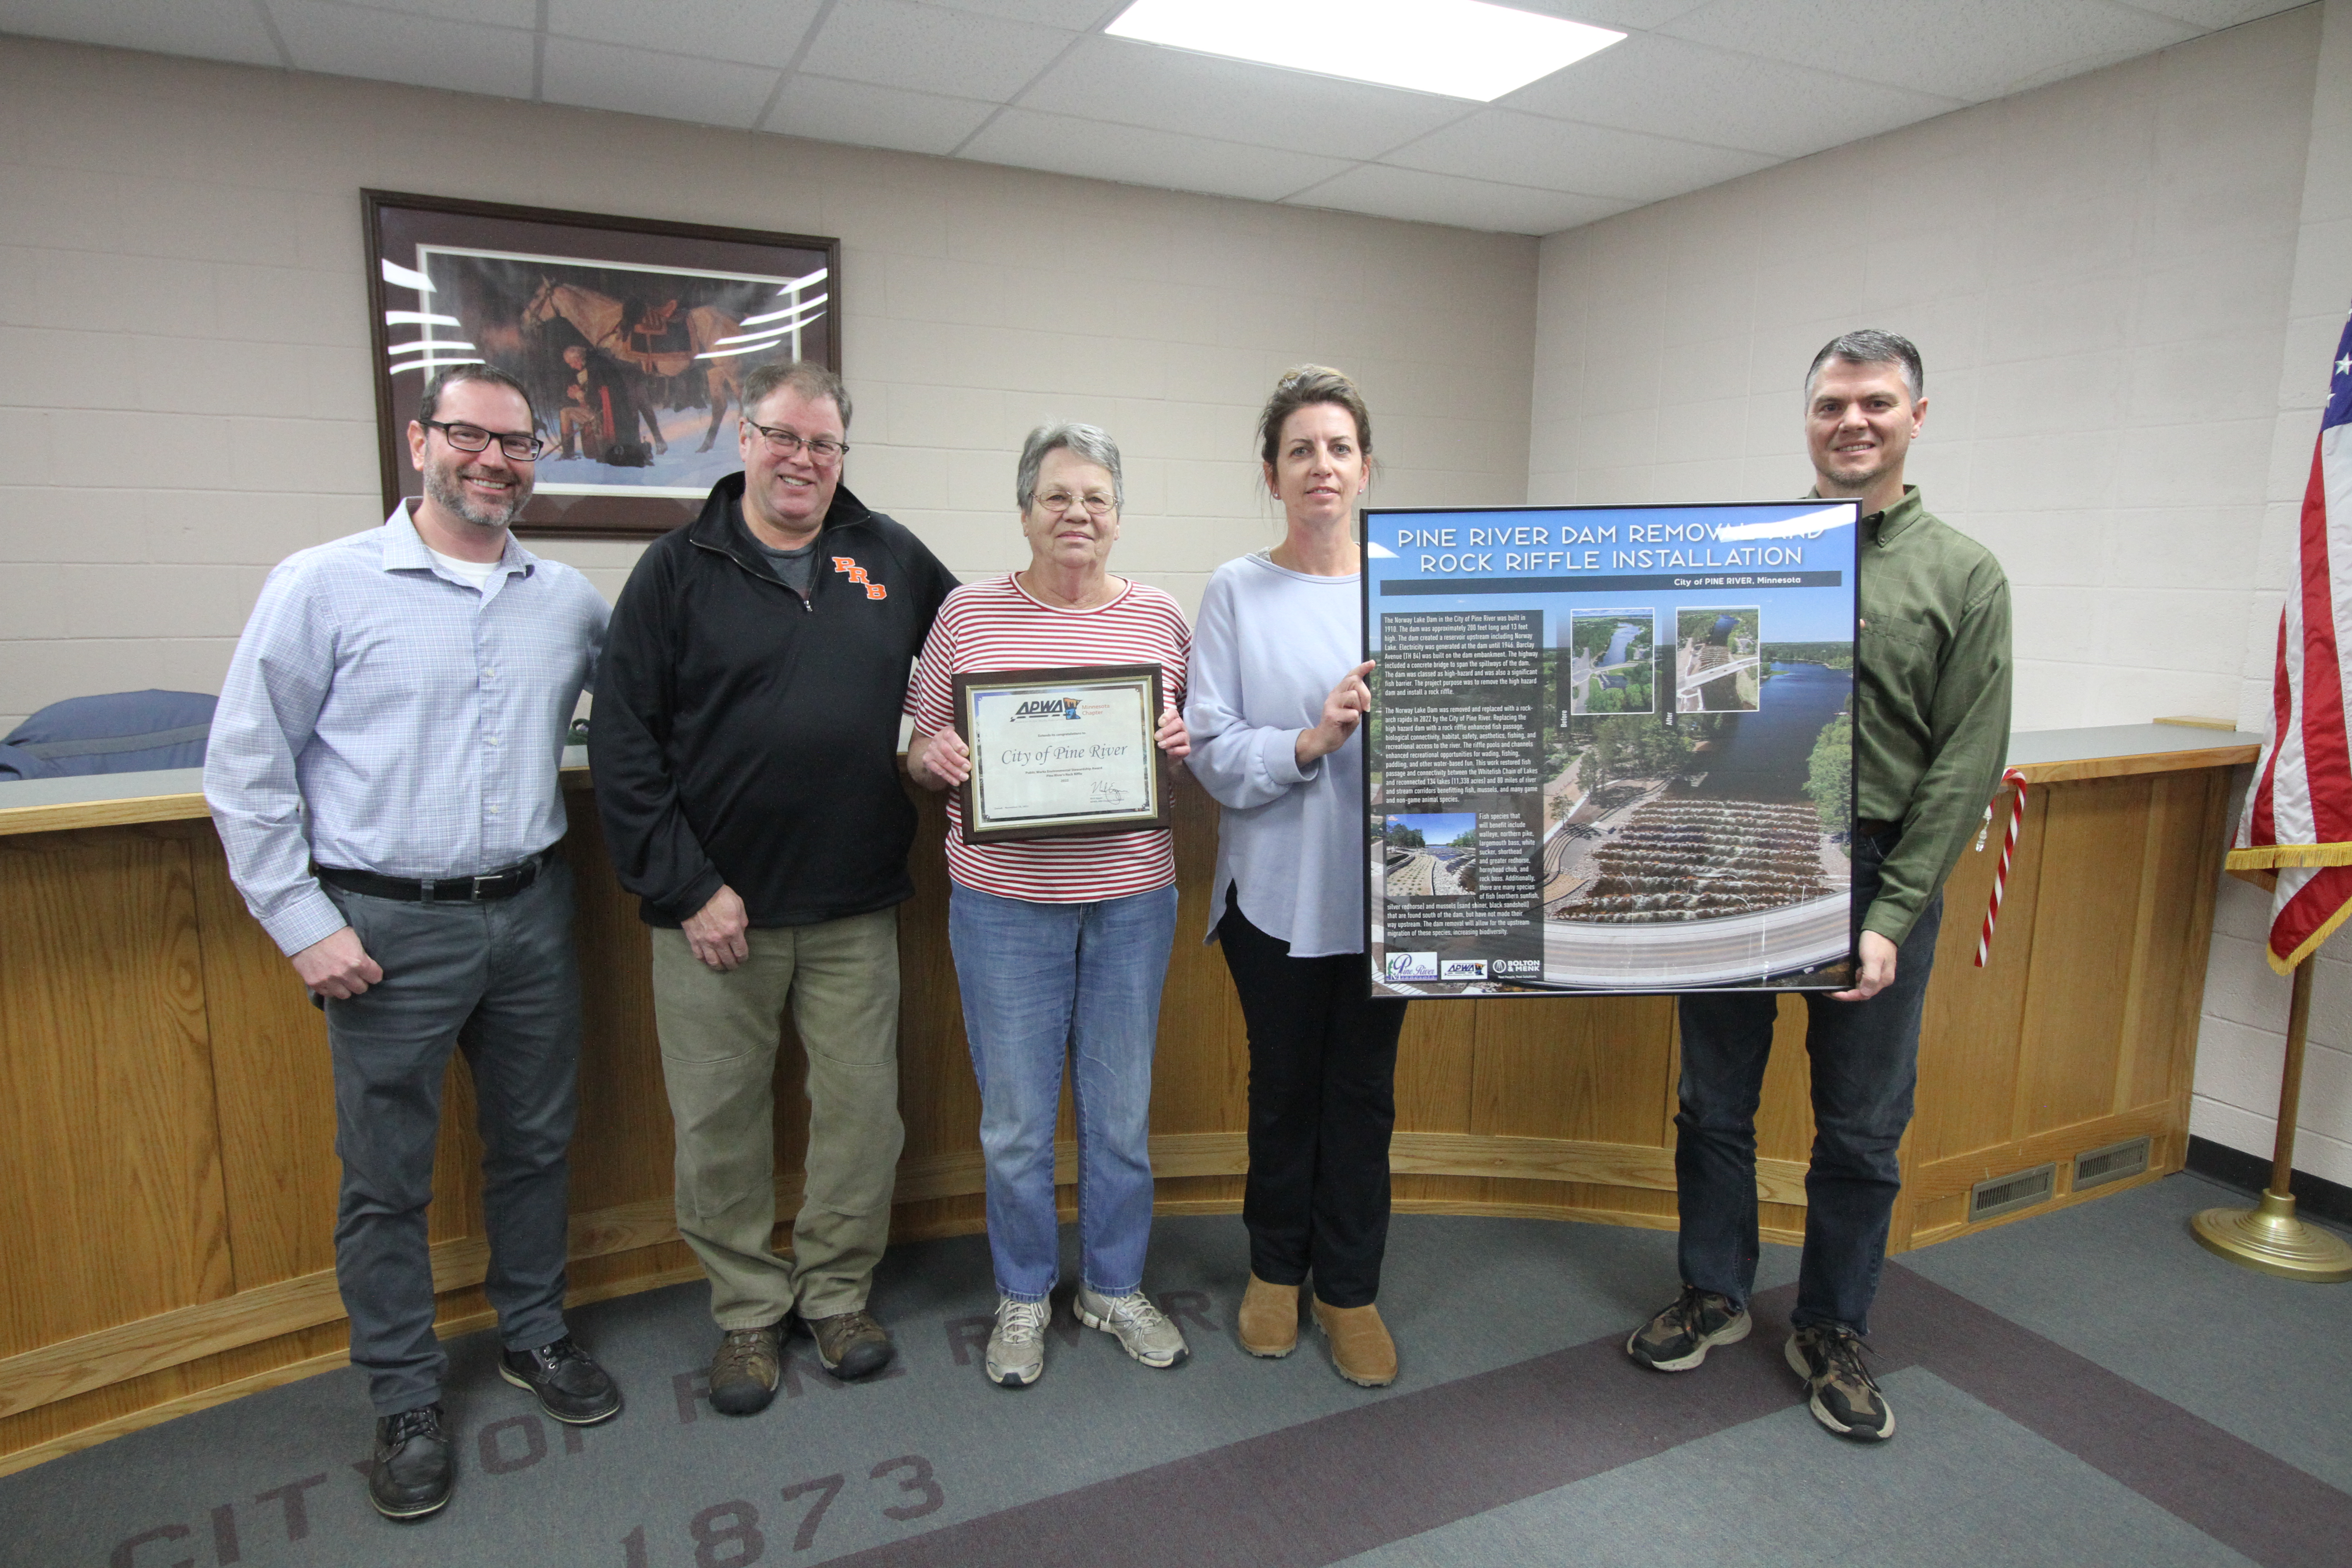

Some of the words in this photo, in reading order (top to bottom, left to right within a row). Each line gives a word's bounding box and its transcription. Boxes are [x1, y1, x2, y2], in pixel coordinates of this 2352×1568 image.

[1398, 529, 1456, 548] PINE
[1470, 527, 1548, 546] RIVER
[1562, 525, 1616, 544] DAM
[1421, 553, 1493, 573] ROCK
[1506, 550, 1600, 571] RIFFLE
[1613, 546, 1802, 568] INSTALLATION
[832, 556, 887, 600] PRB
[1674, 578, 1691, 587] City
[1511, 668, 1537, 676] significant
[1016, 700, 1063, 715] APWA
[1001, 749, 1030, 767] City
[1035, 745, 1052, 765] of
[1054, 746, 1085, 760] Pine
[1089, 744, 1128, 760] River
[1447, 964, 1474, 972] APWA
[620, 1454, 944, 1568] 1873
